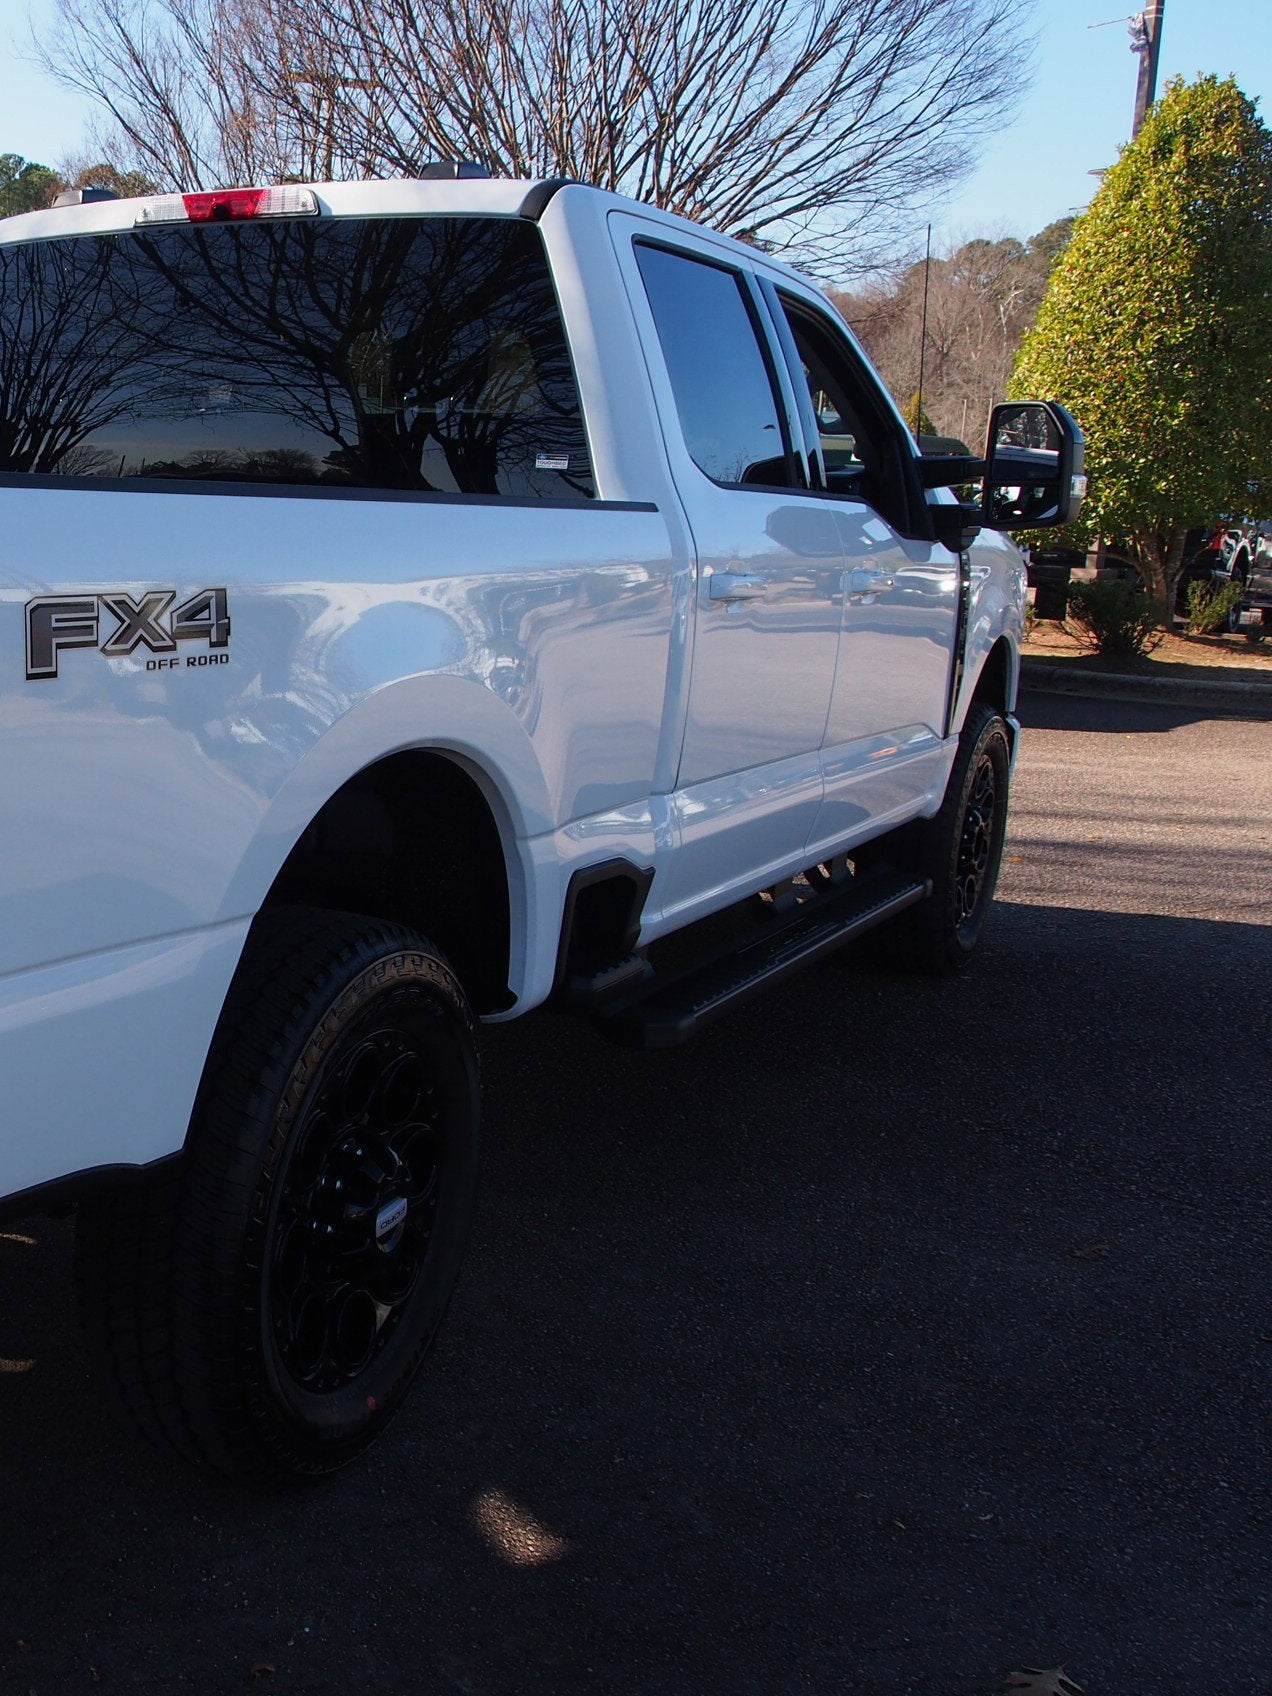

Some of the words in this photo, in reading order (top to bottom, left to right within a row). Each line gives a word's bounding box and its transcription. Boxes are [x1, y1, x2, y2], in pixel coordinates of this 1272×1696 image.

[25, 588, 230, 680] FX4
[146, 658, 180, 671] OFF
[186, 654, 230, 668] ROAD
